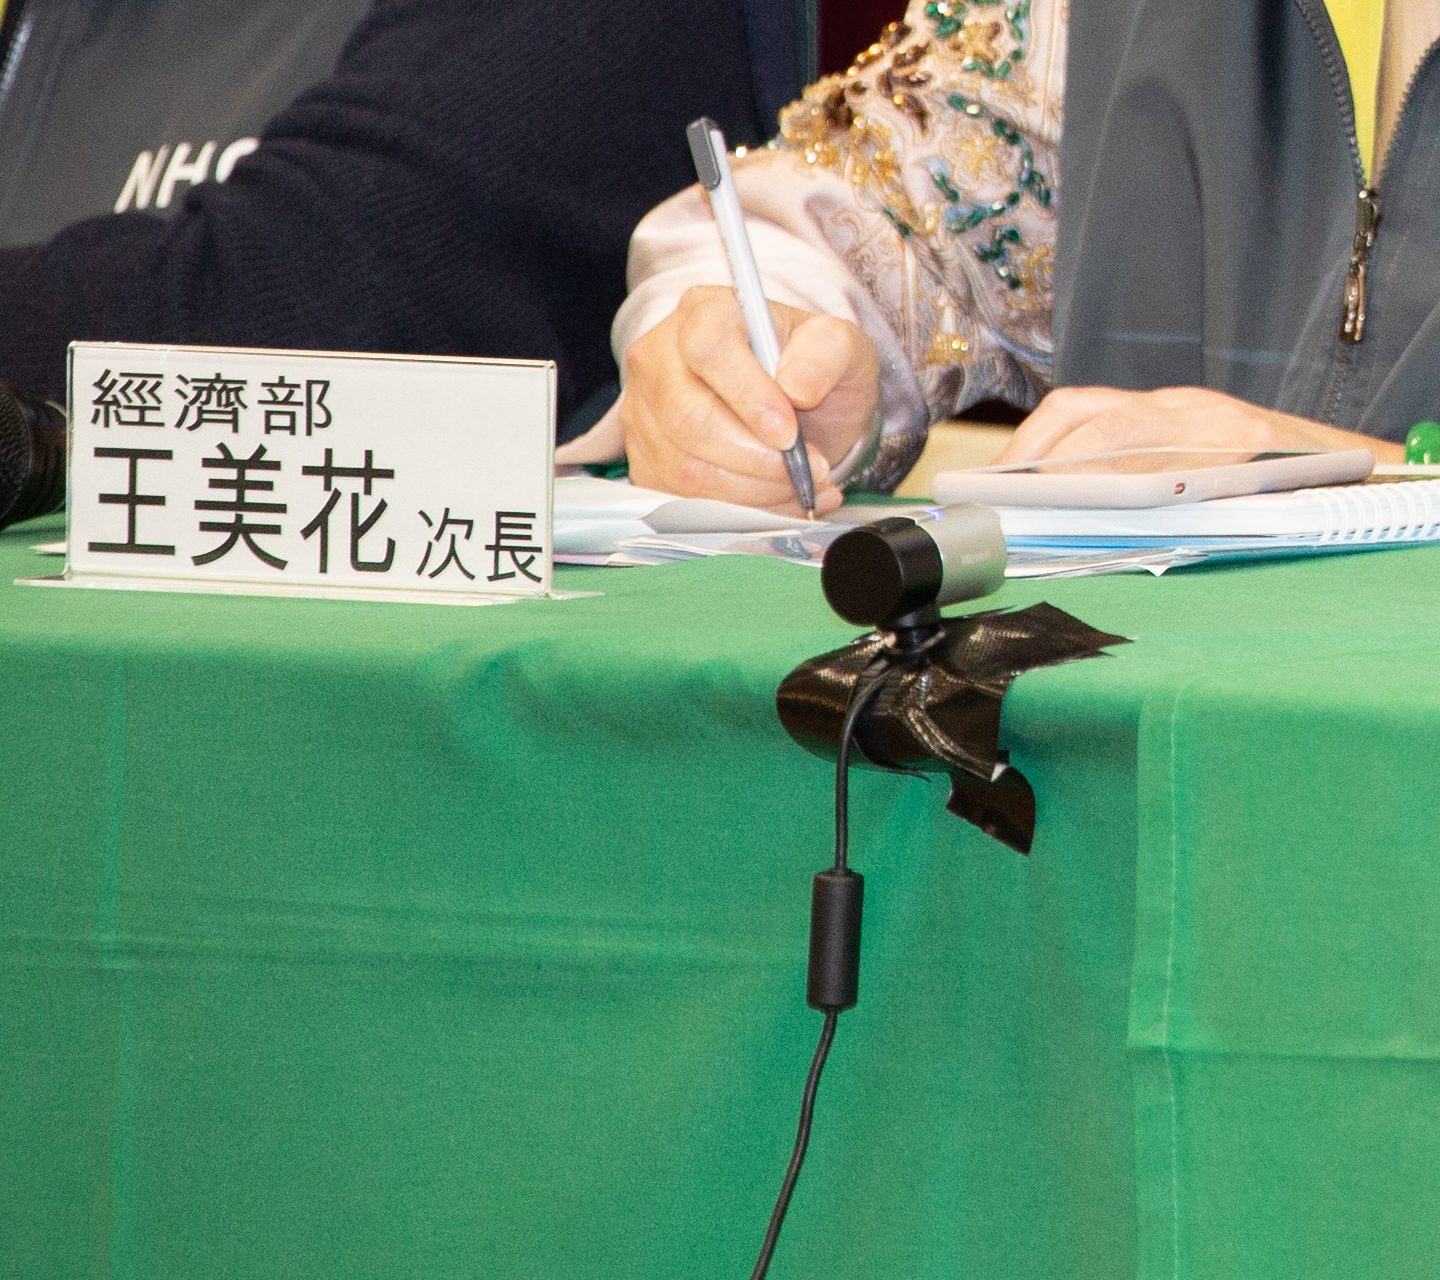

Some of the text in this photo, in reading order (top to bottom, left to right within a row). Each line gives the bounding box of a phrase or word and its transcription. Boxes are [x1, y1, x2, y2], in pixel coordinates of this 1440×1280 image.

[90, 368, 333, 437] 經濟部
[87, 442, 544, 584] 王美花 次長
